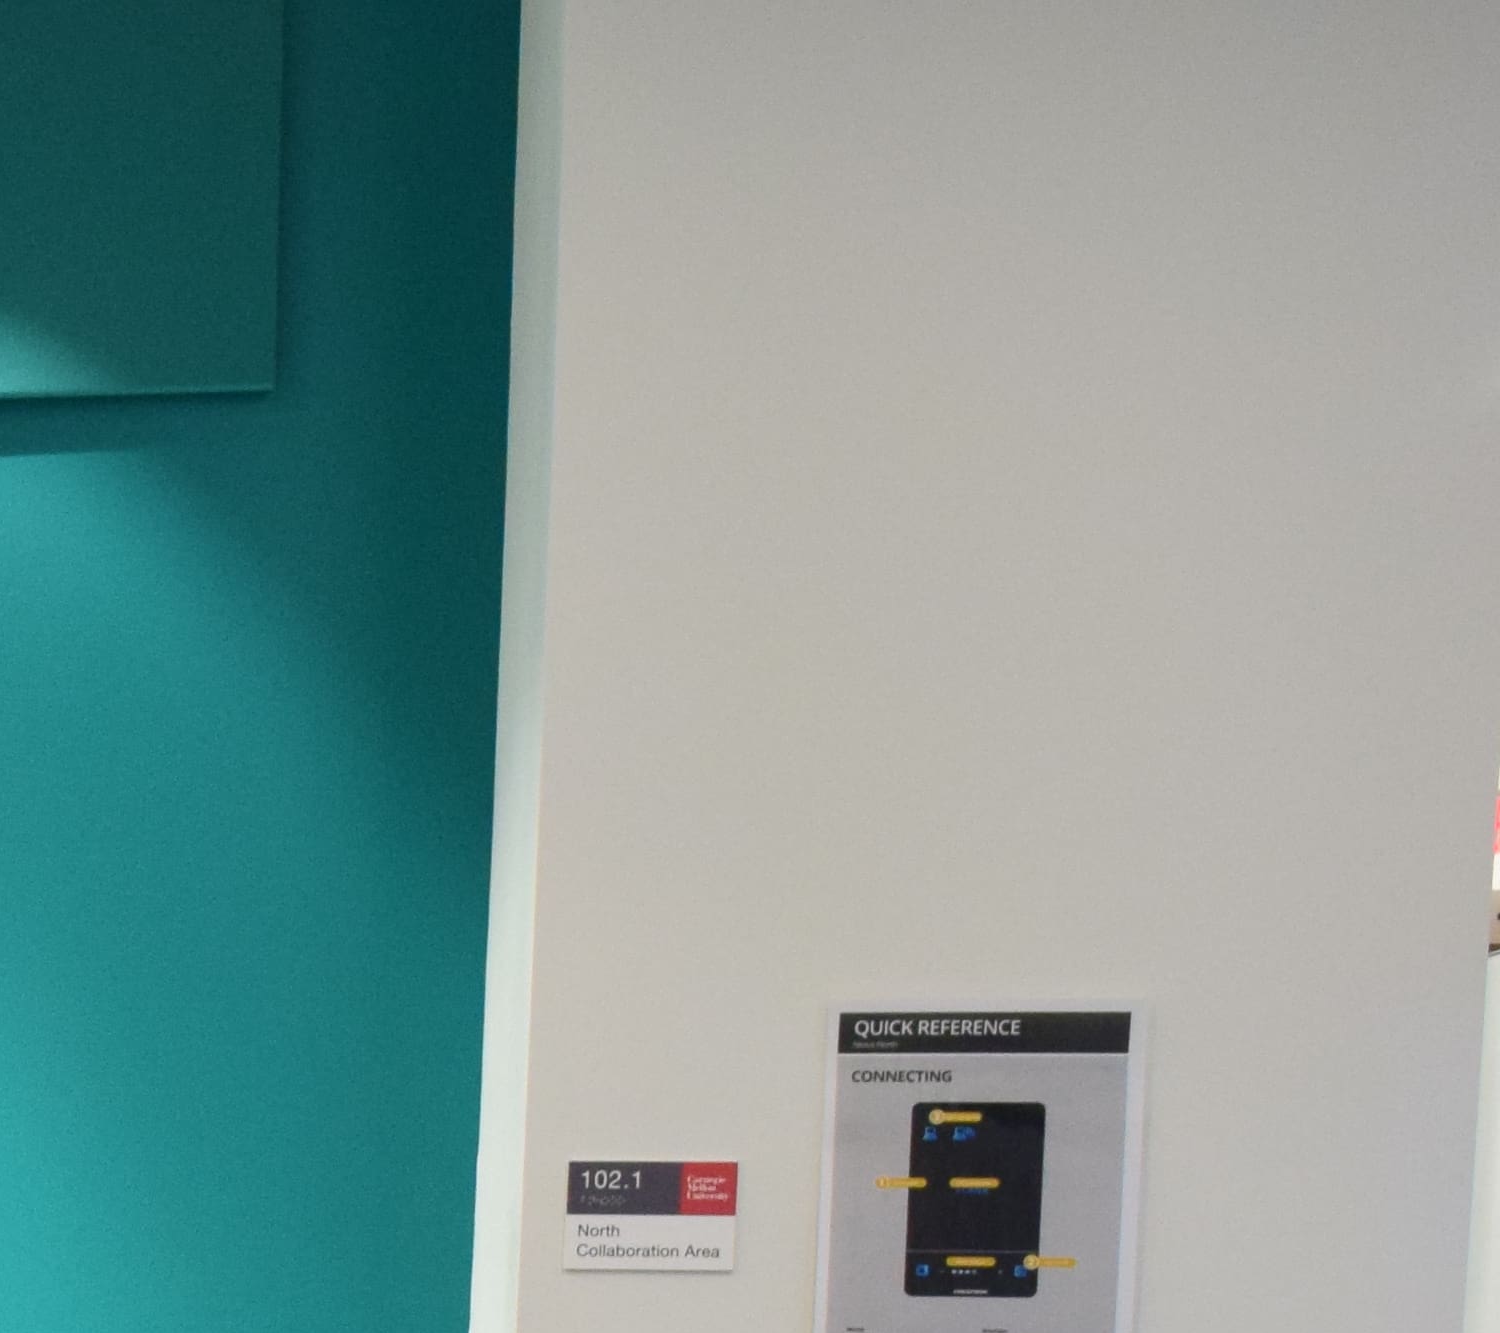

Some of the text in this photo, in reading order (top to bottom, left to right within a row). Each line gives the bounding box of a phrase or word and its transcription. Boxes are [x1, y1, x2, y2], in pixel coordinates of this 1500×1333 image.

[854, 1019, 1021, 1038] QUICK REFERENCE
[851, 1070, 952, 1083] CONNECTING
[581, 1169, 641, 1189] 102.1
[577, 1223, 620, 1237] North
[576, 1243, 720, 1258] Collaboration Area
